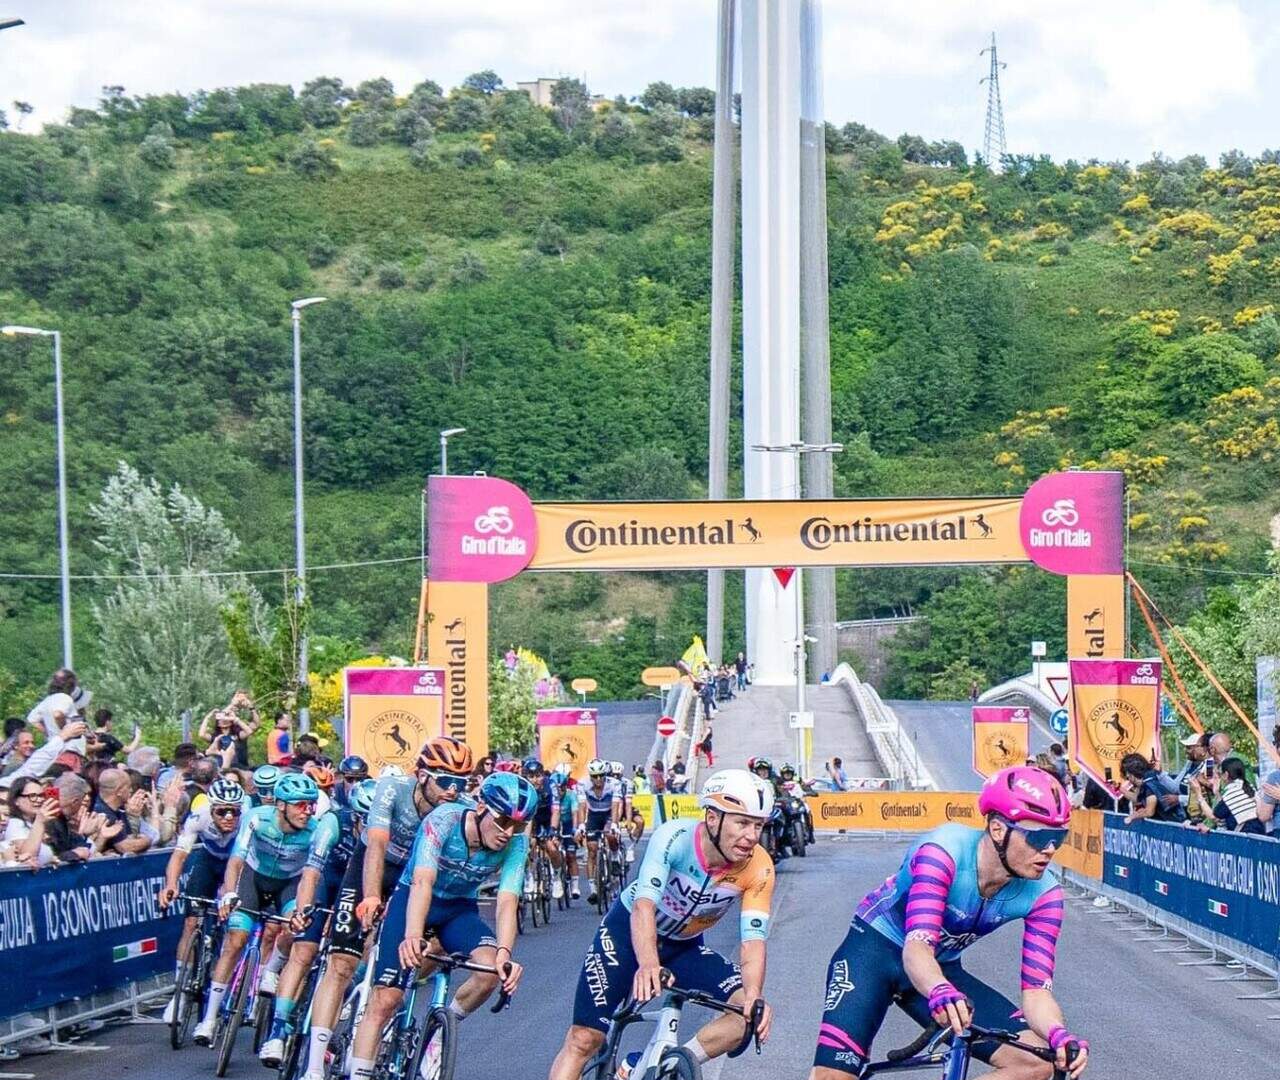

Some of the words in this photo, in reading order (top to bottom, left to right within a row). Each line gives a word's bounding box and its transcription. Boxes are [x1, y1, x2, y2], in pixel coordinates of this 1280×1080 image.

[565, 518, 734, 553] Continental
[800, 515, 967, 551] Continental
[1030, 528, 1053, 547] Giro
[1055, 528, 1091, 548] d'Italia
[462, 536, 487, 555] Giro
[446, 639, 466, 744] ntinental
[367, 710, 424, 734] CONTINENTAL
[1090, 699, 1141, 722] CONTINENTAL
[821, 802, 858, 820] Continental
[881, 802, 921, 820] Continental
[42, 892, 59, 942] IO
[60, 886, 100, 939] SONO
[100, 882, 130, 931] FRIULI
[336, 887, 357, 934] INEOS
